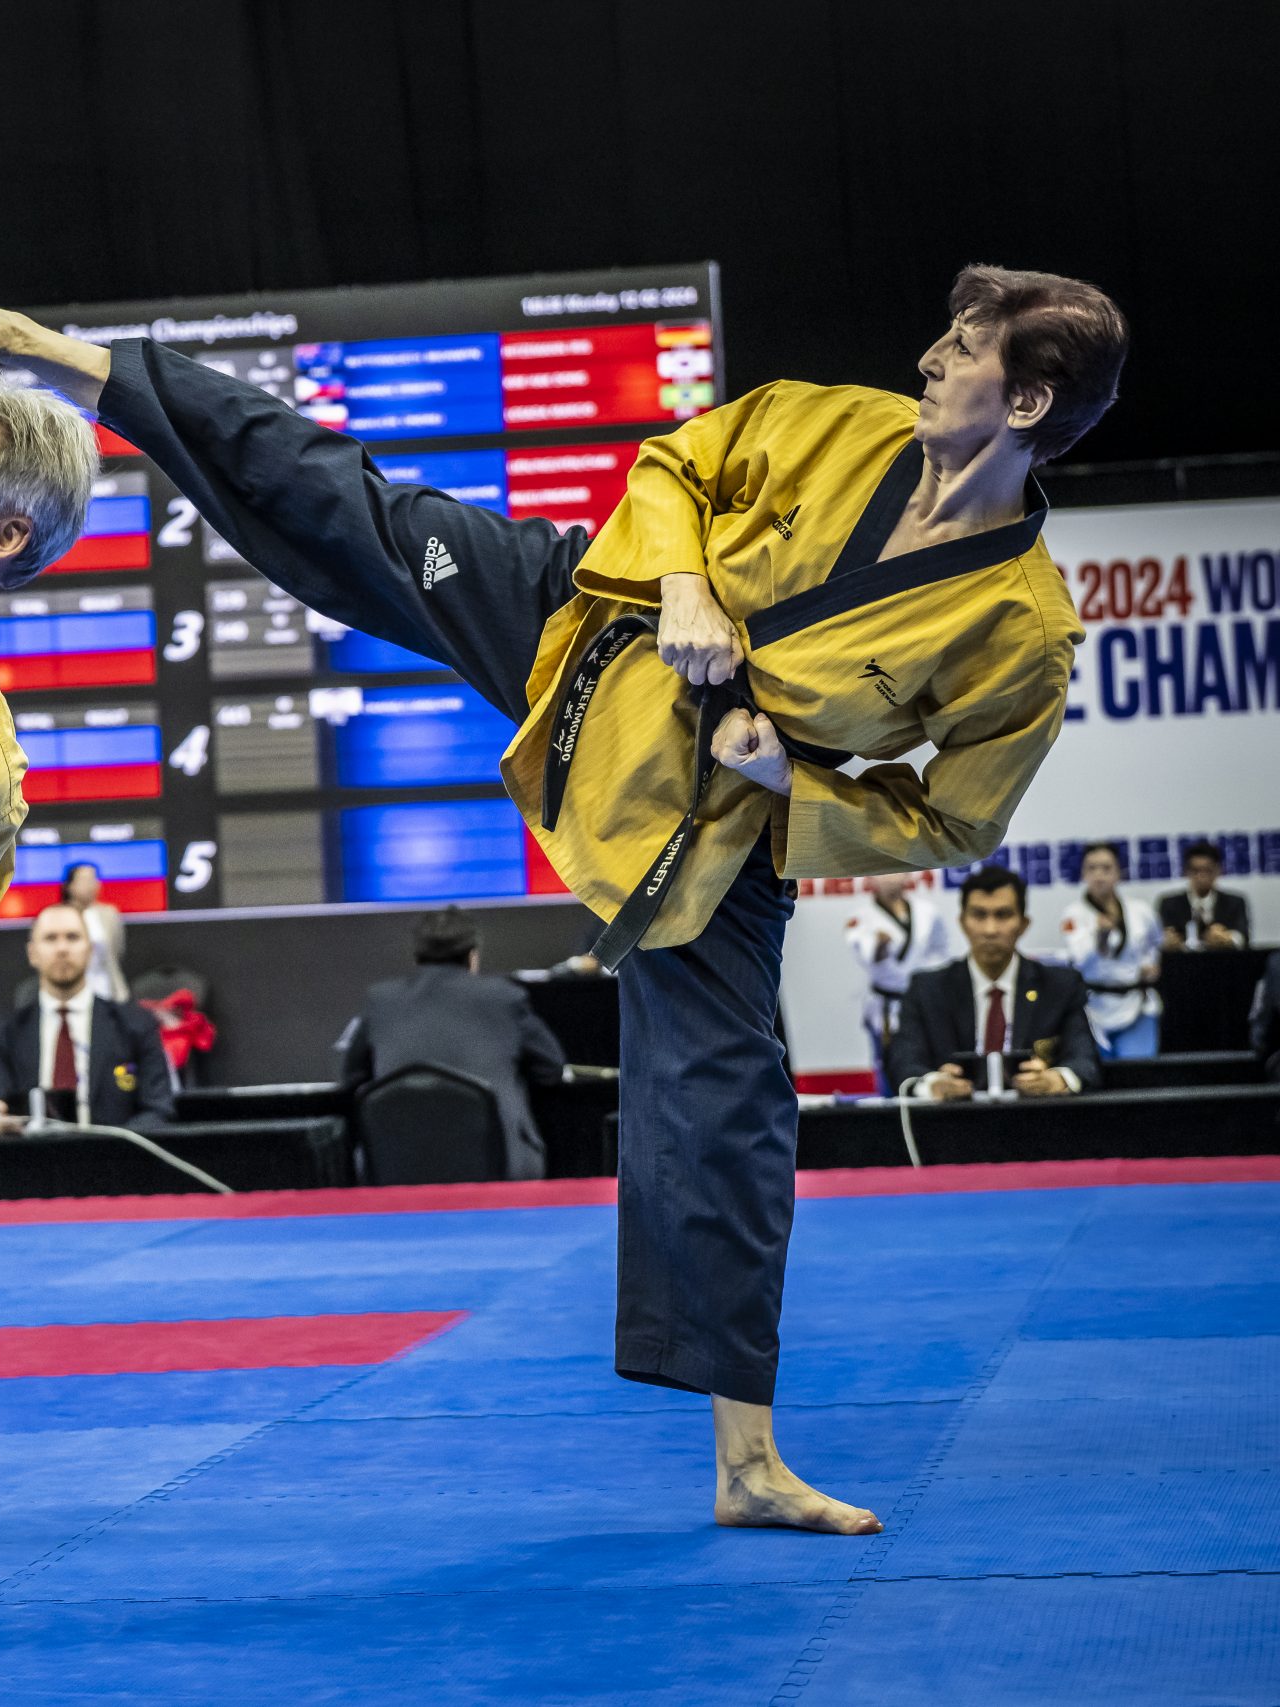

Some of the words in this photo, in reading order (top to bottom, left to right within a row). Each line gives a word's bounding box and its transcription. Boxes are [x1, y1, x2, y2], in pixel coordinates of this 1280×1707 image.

[157, 497, 199, 548] 2
[423, 536, 439, 590] adidas
[1077, 554, 1195, 623] 2024
[163, 610, 205, 662] 3
[169, 725, 210, 776] 4
[174, 841, 216, 892] 5
